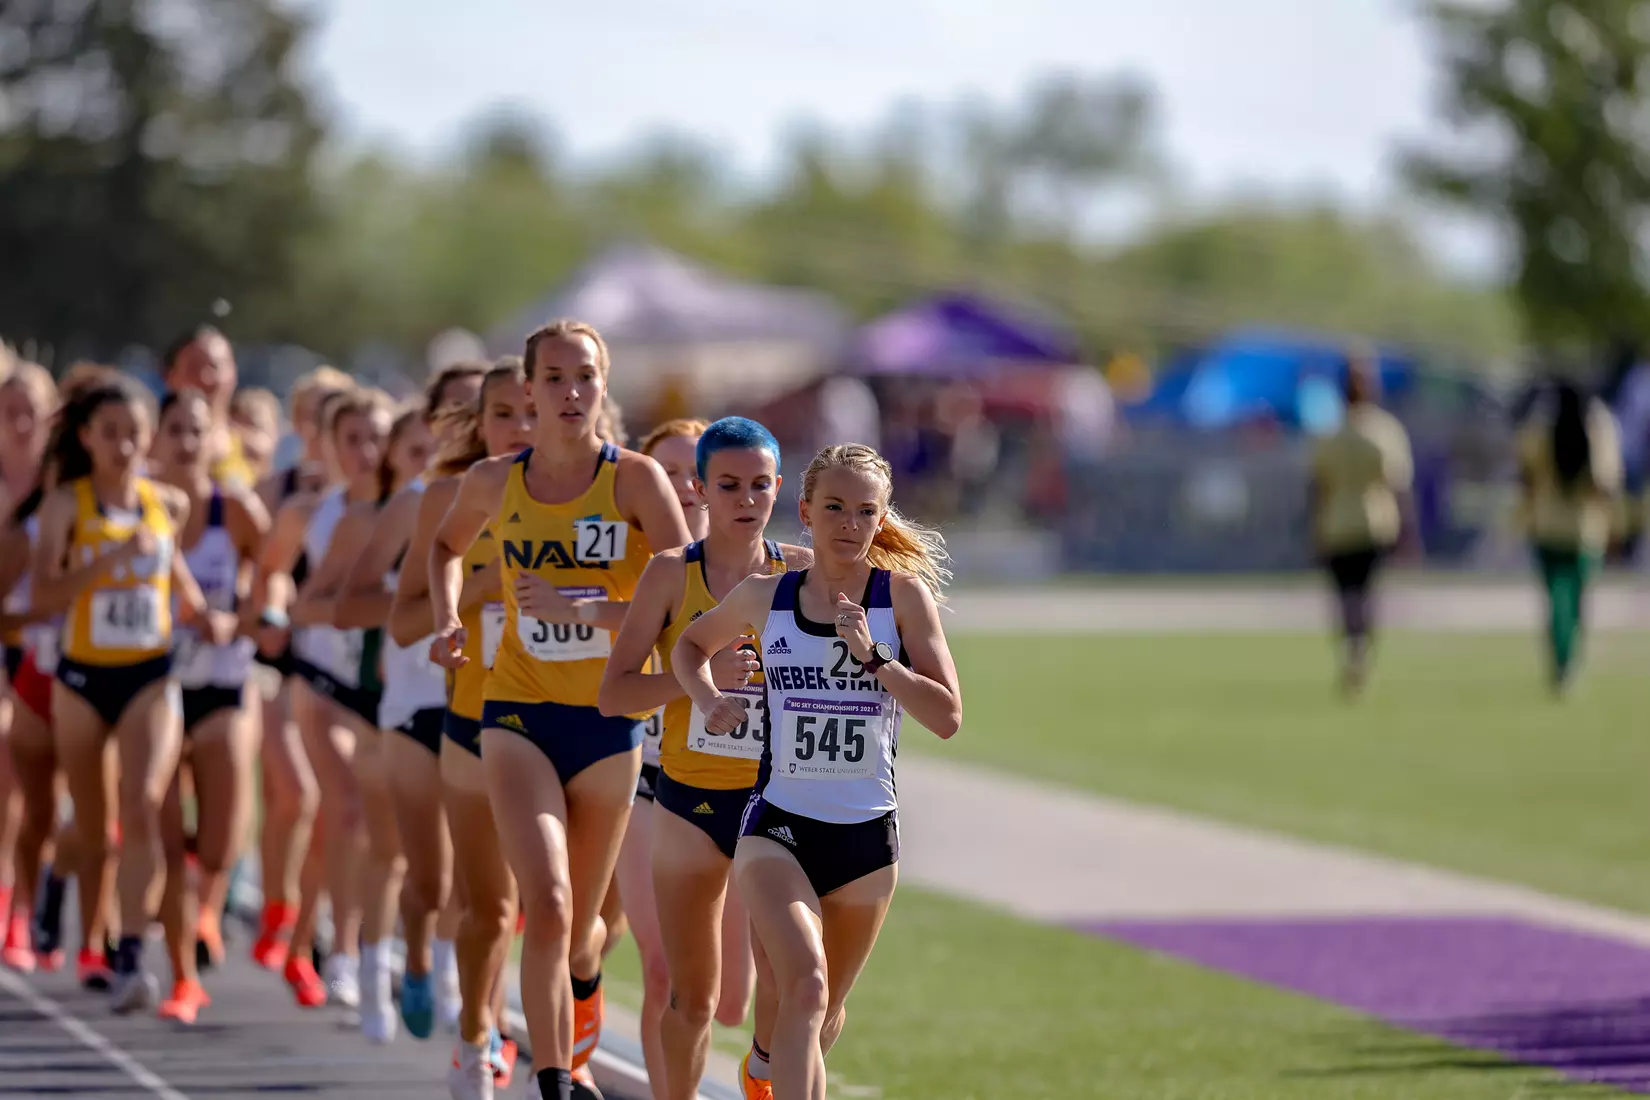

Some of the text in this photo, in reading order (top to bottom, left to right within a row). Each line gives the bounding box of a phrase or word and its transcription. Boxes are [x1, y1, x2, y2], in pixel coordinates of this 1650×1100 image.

[585, 524, 617, 558] 21
[767, 646, 792, 655] adidas
[766, 666, 830, 691] WEBER
[812, 703, 859, 712] CHAMPIONSHIPS
[795, 715, 866, 763] 545
[767, 828, 798, 847] adidas
